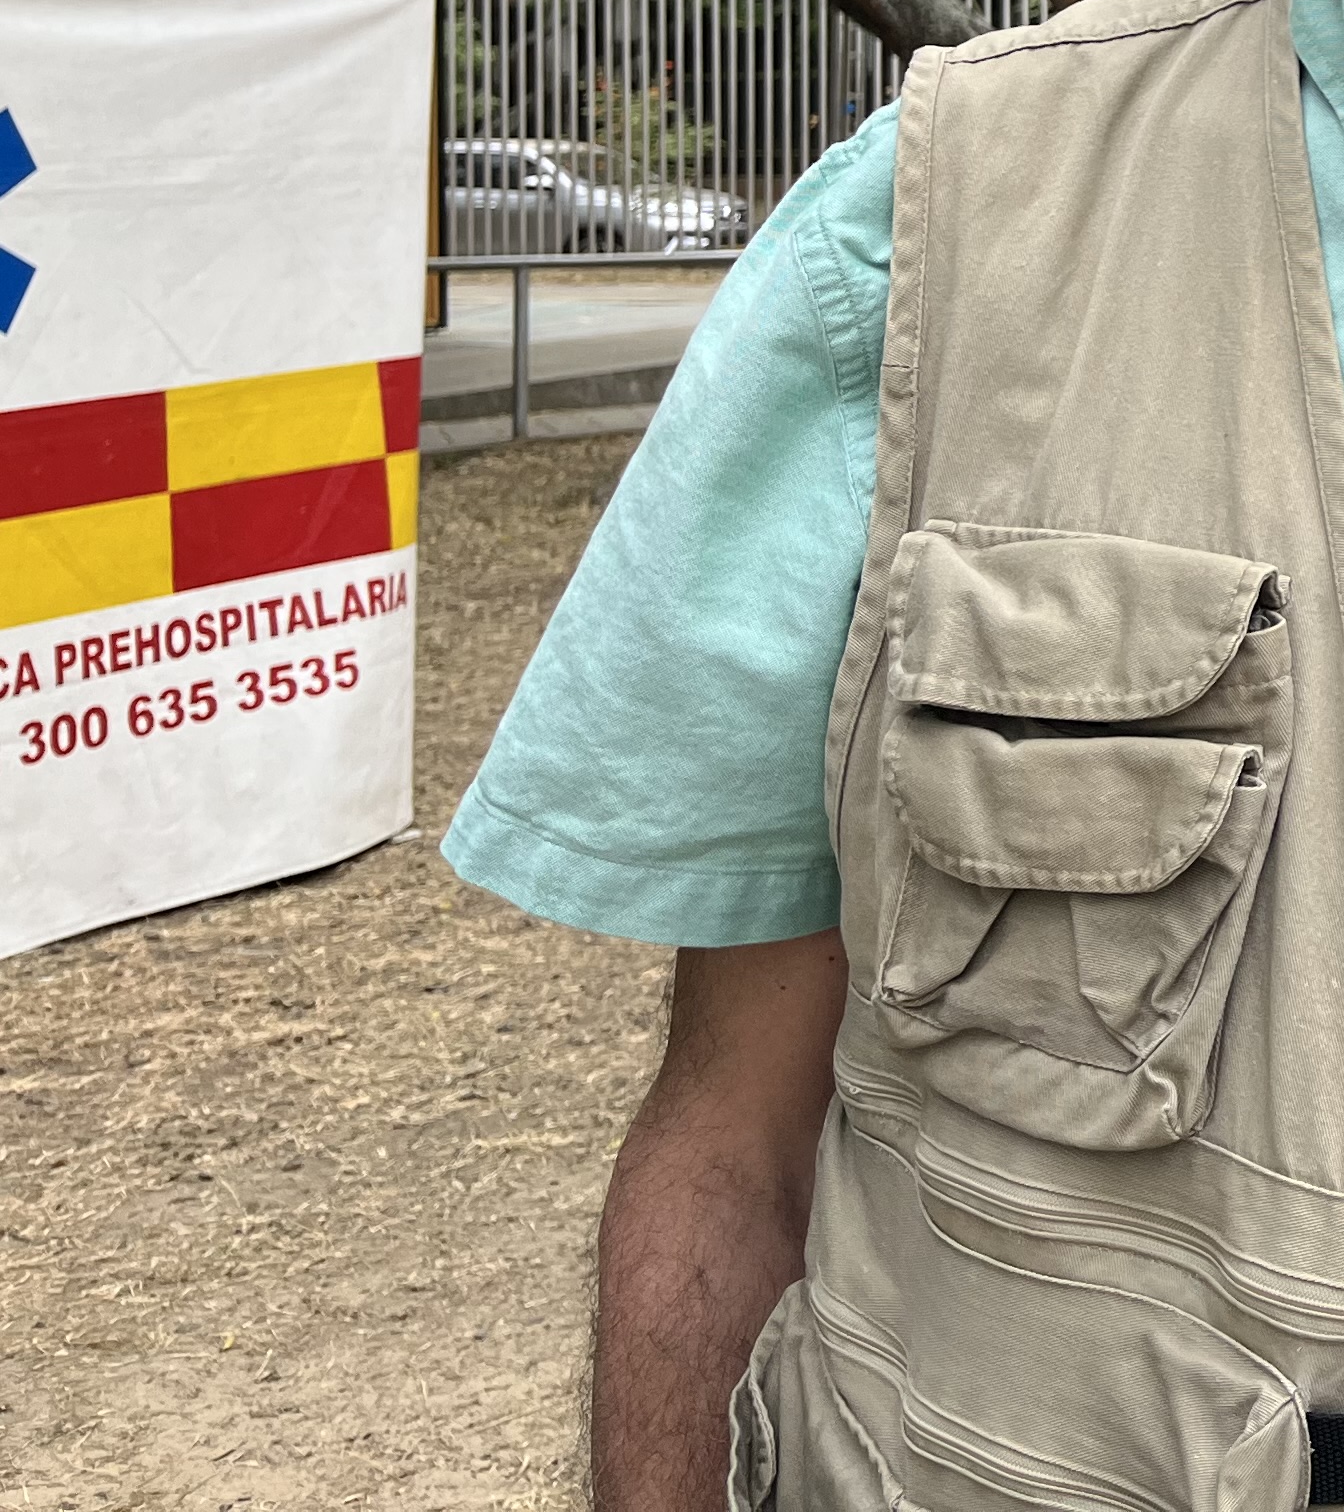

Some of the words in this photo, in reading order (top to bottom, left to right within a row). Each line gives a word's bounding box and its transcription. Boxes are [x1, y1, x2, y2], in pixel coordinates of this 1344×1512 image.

[54, 572, 408, 687] PREHOSPITALARIA
[19, 705, 109, 765] 300
[126, 680, 219, 738] 635
[235, 649, 361, 712] 3535
